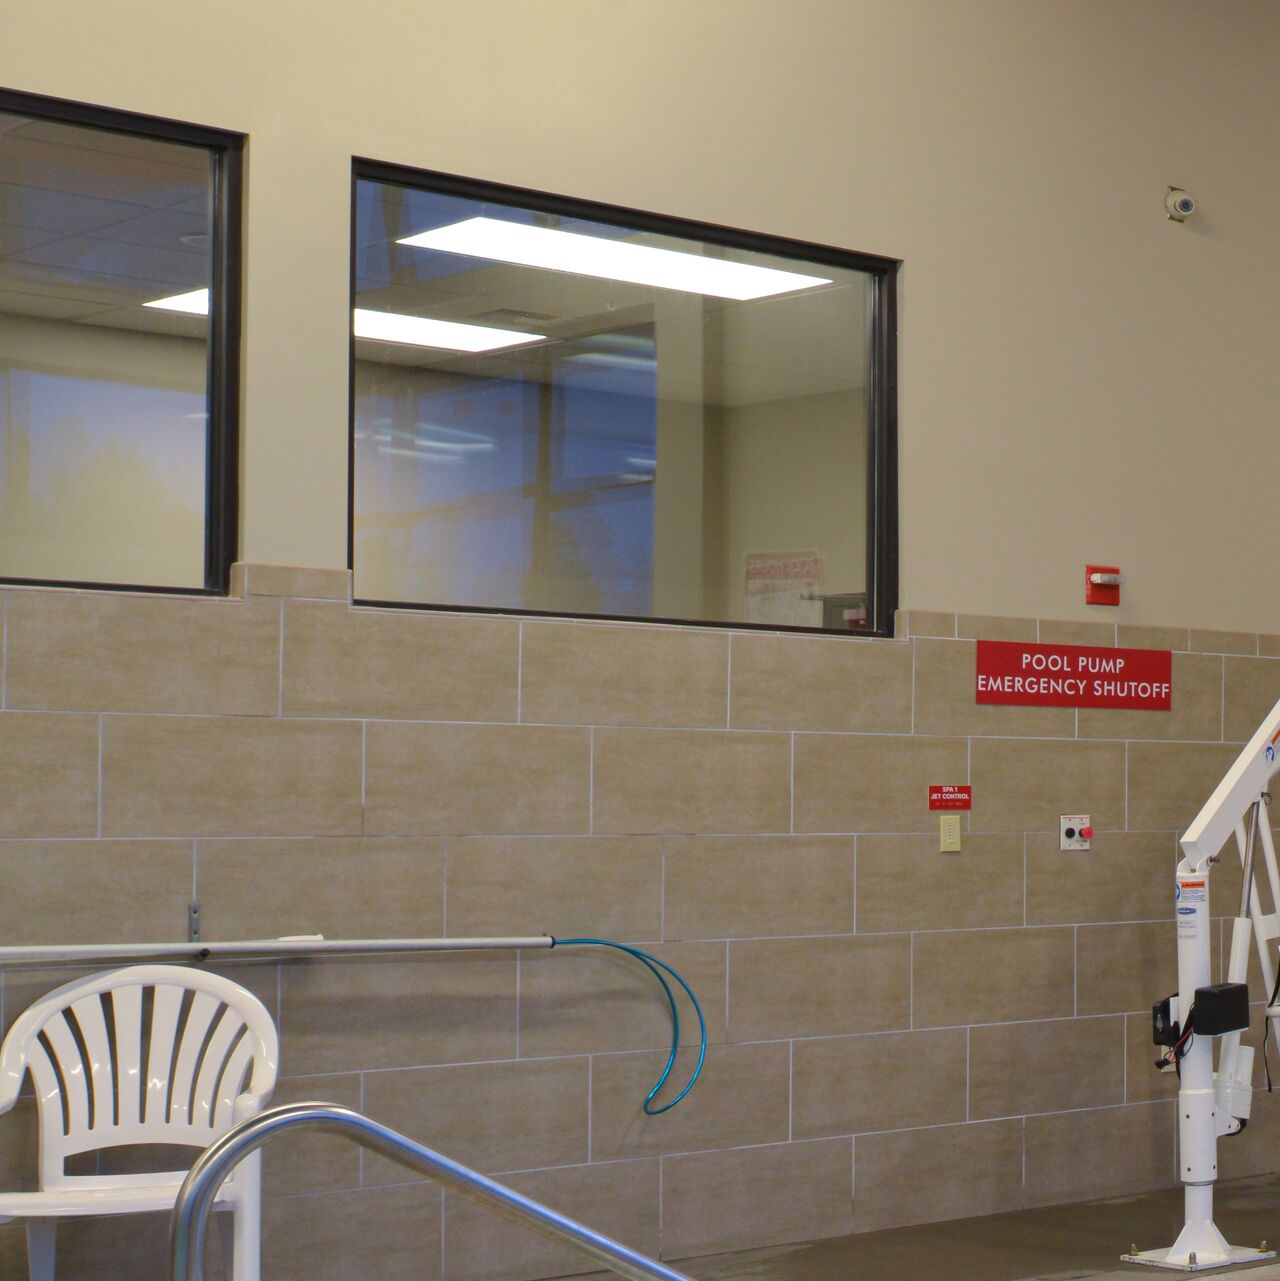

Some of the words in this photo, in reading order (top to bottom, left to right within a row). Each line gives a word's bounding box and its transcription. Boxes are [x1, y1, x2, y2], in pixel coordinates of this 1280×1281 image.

[1022, 654, 1071, 672] POOL
[1078, 656, 1125, 674] PUMP
[978, 674, 1086, 696] EMERGENCY
[1093, 680, 1170, 698] SHUTOFF
